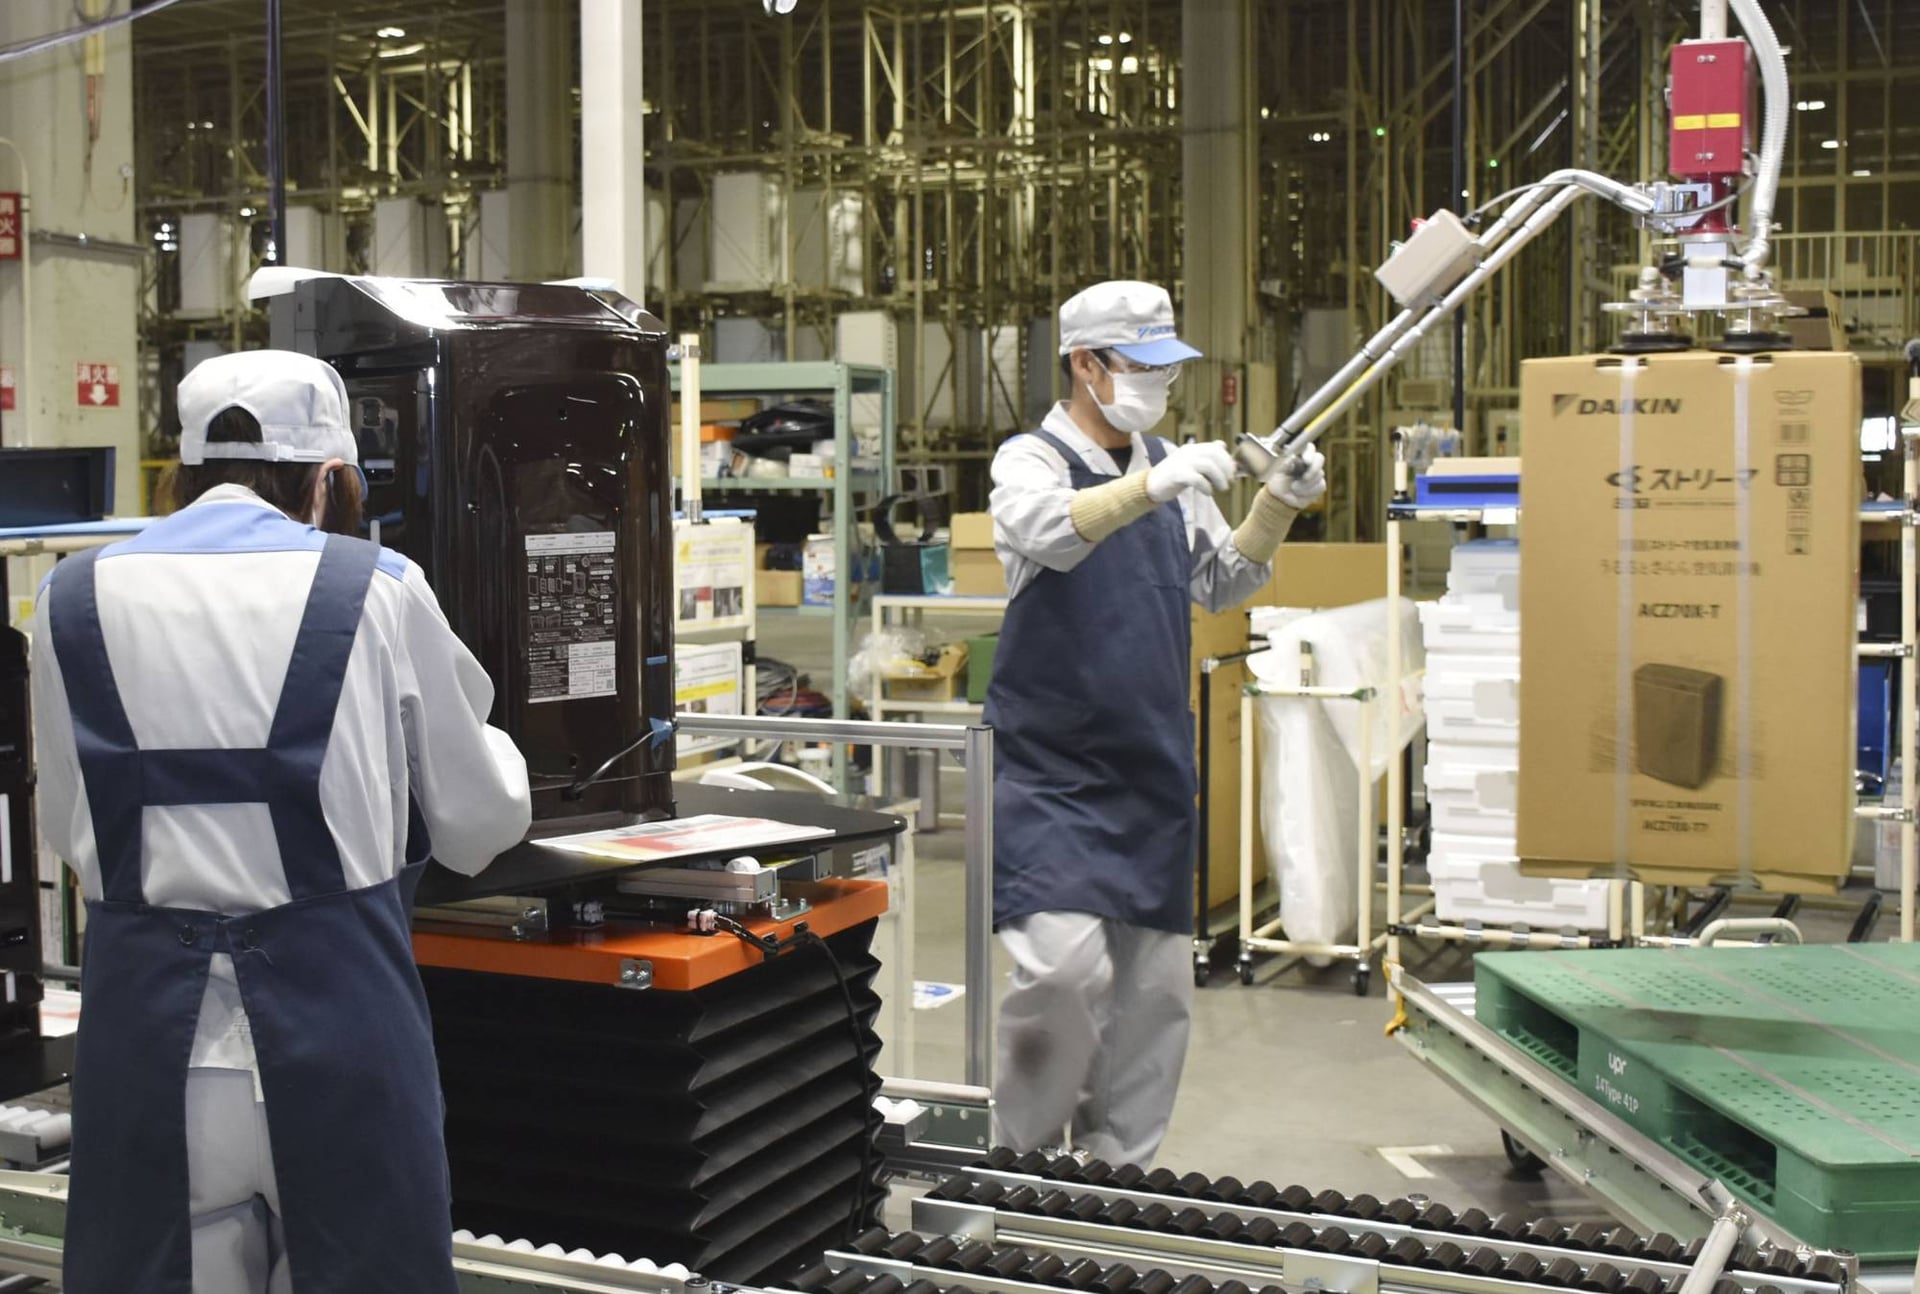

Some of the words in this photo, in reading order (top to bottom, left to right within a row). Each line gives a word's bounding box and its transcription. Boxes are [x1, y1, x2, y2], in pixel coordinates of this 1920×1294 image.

[1577, 398, 1683, 415] DAIKIN
[1649, 469, 1760, 490] ストリーマ
[1608, 1051, 1627, 1076] upr
